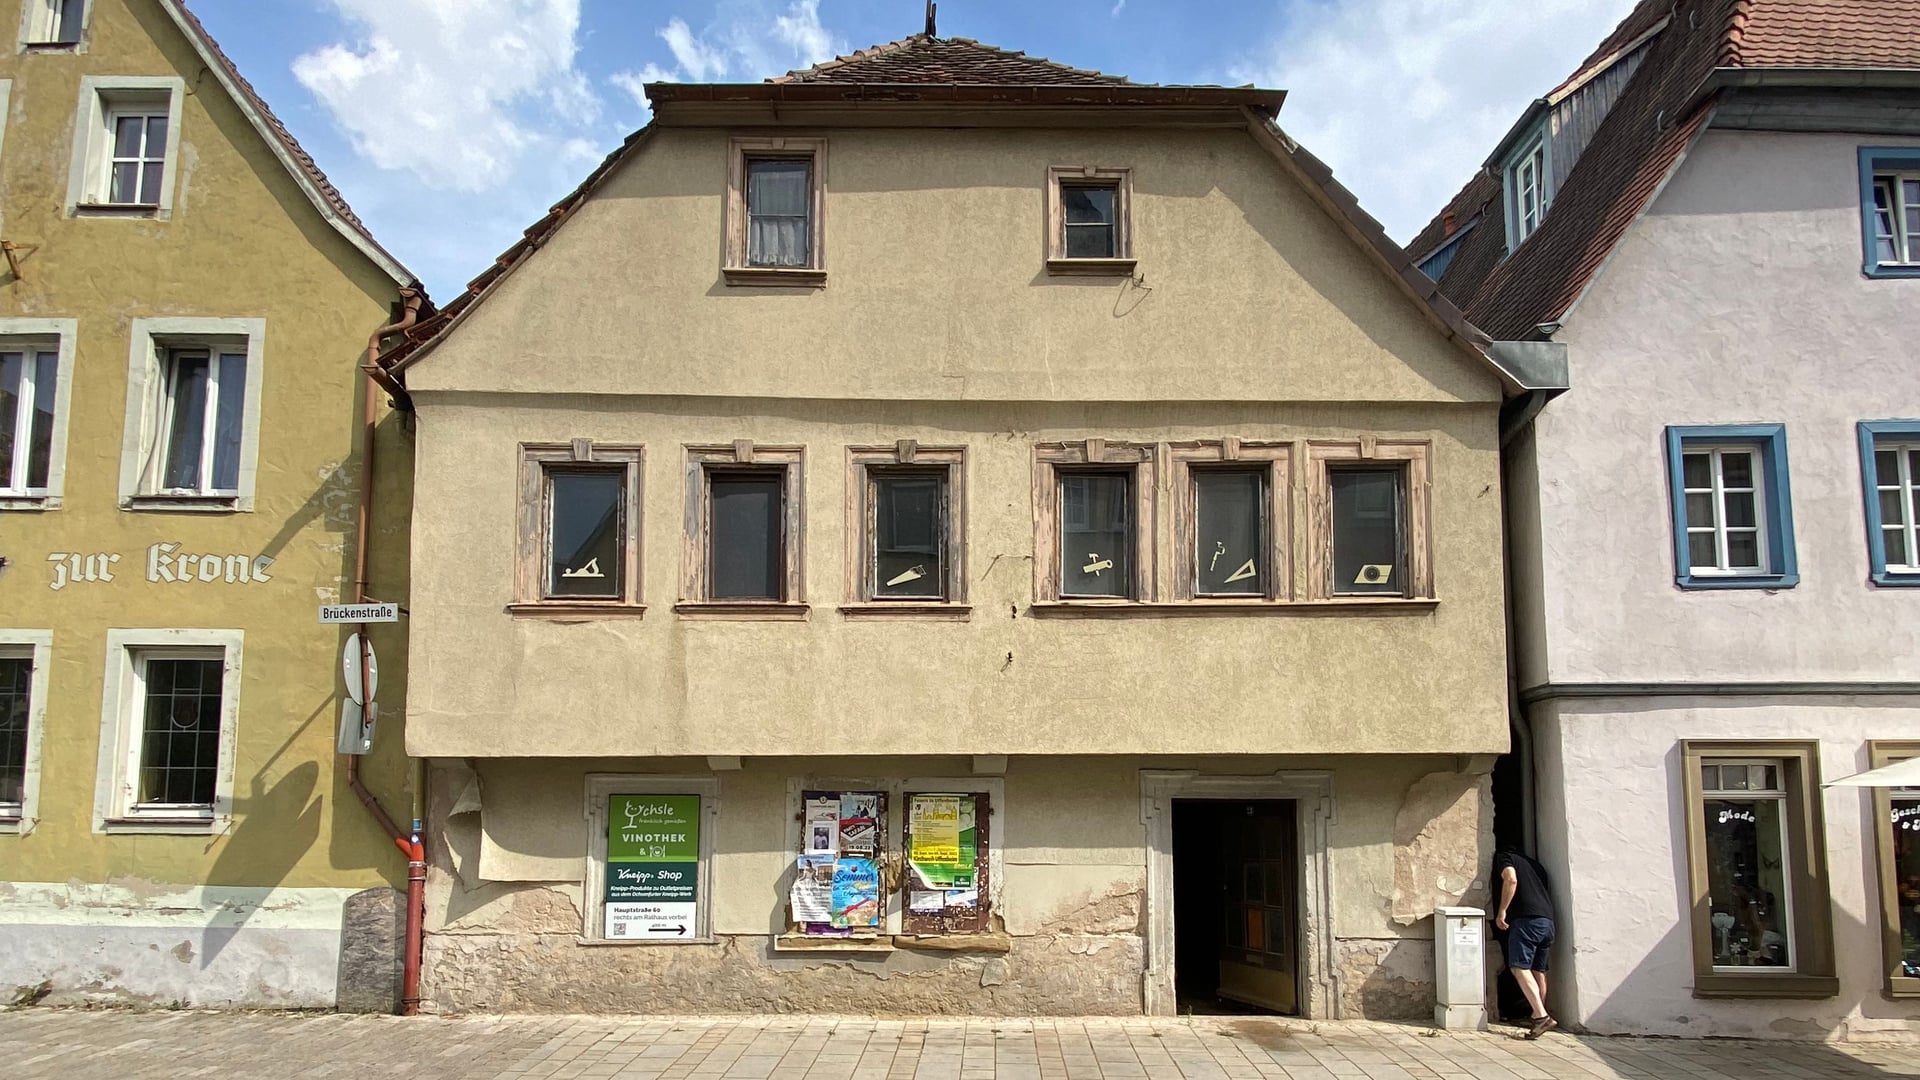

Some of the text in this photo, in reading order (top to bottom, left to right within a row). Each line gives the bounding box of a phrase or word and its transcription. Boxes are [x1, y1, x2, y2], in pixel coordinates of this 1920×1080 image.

[46, 540, 277, 592] zur Krone
[322, 605, 393, 620] Brückenstraße
[1718, 808, 1755, 824] Mode
[622, 833, 686, 842] VINOTHEK
[639, 847, 646, 856] &
[657, 870, 683, 882] Shop
